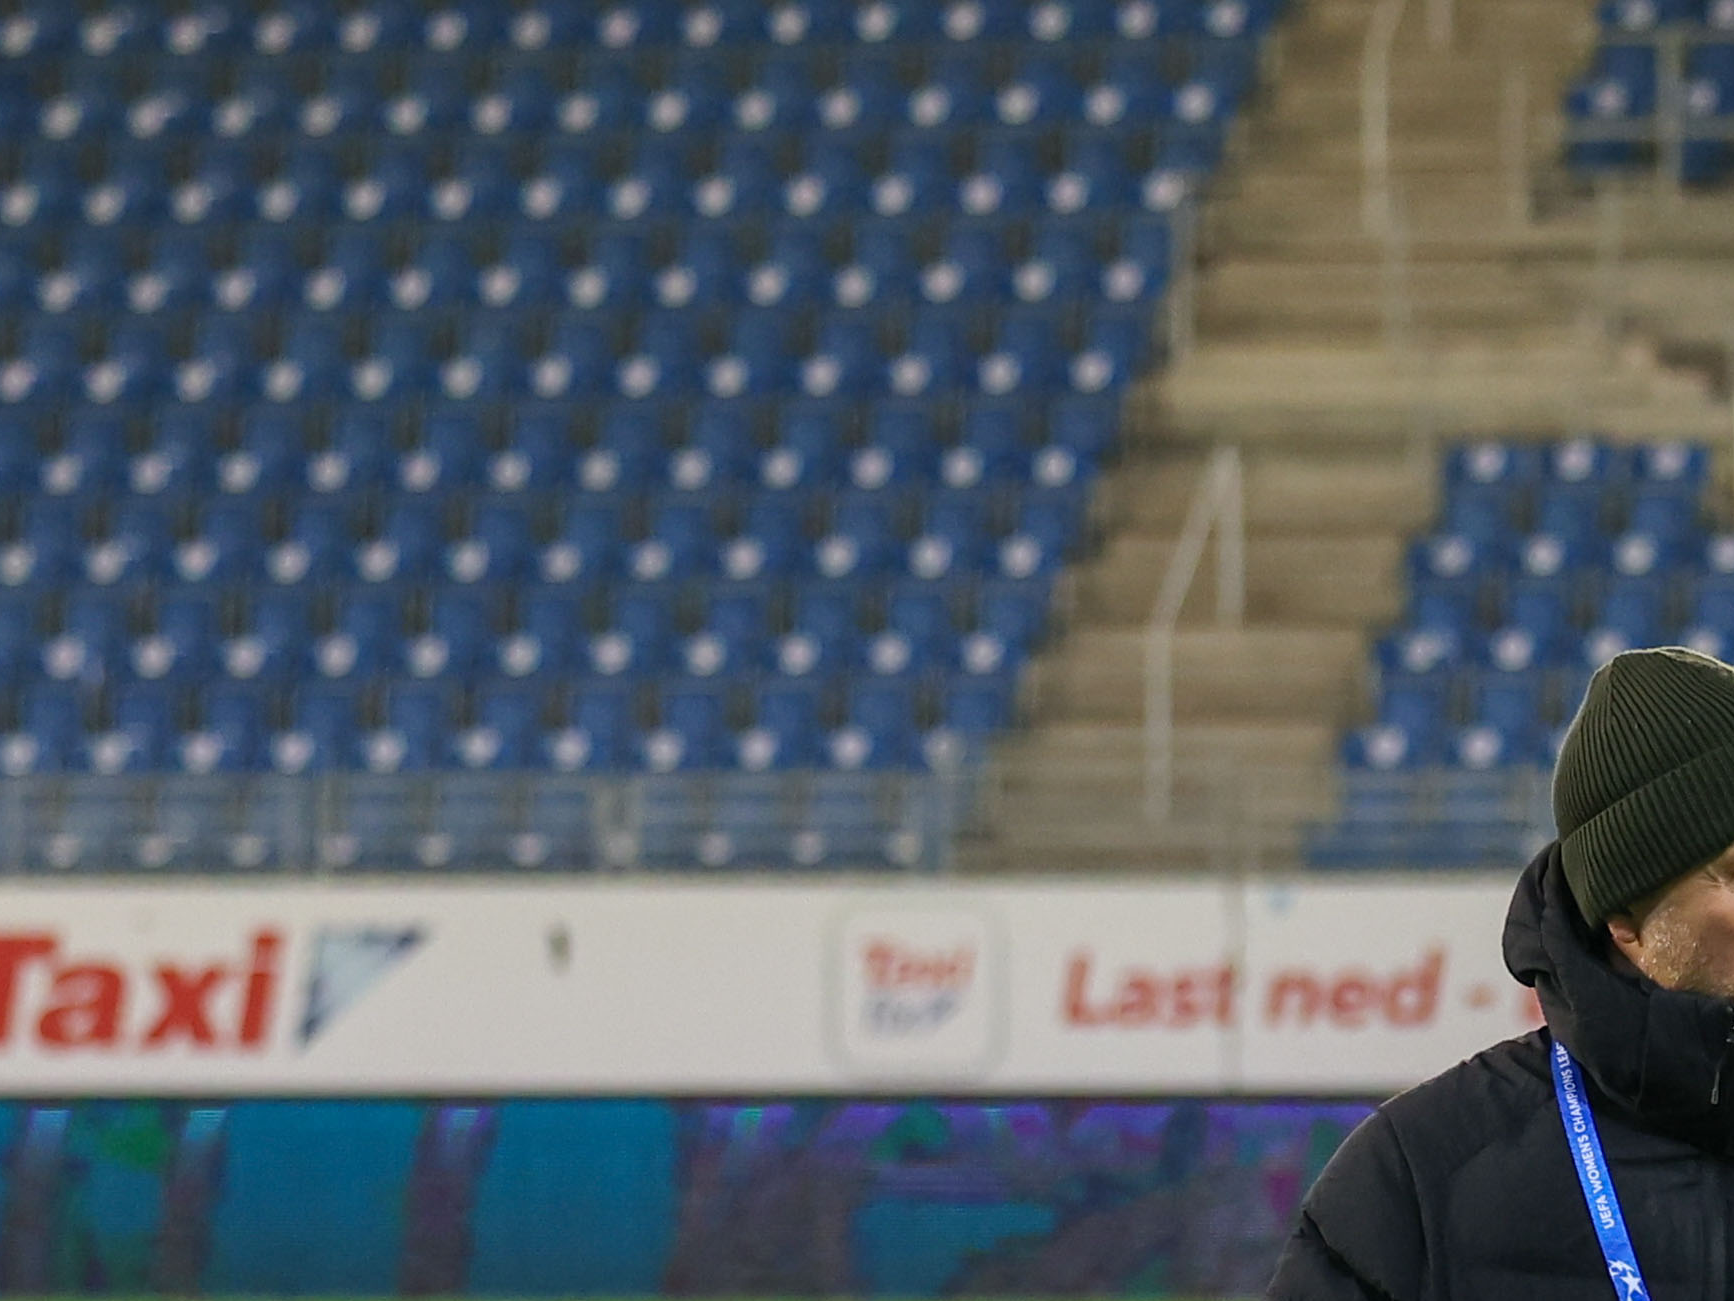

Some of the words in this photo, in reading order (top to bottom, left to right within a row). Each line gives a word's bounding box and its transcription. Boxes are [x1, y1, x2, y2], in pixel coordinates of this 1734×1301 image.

[1060, 950, 1238, 1030] Last
[1264, 942, 1446, 1029] ned
[1561, 1068, 1586, 1132] CHAMPIONS
[1596, 1193, 1615, 1229] UEFA
